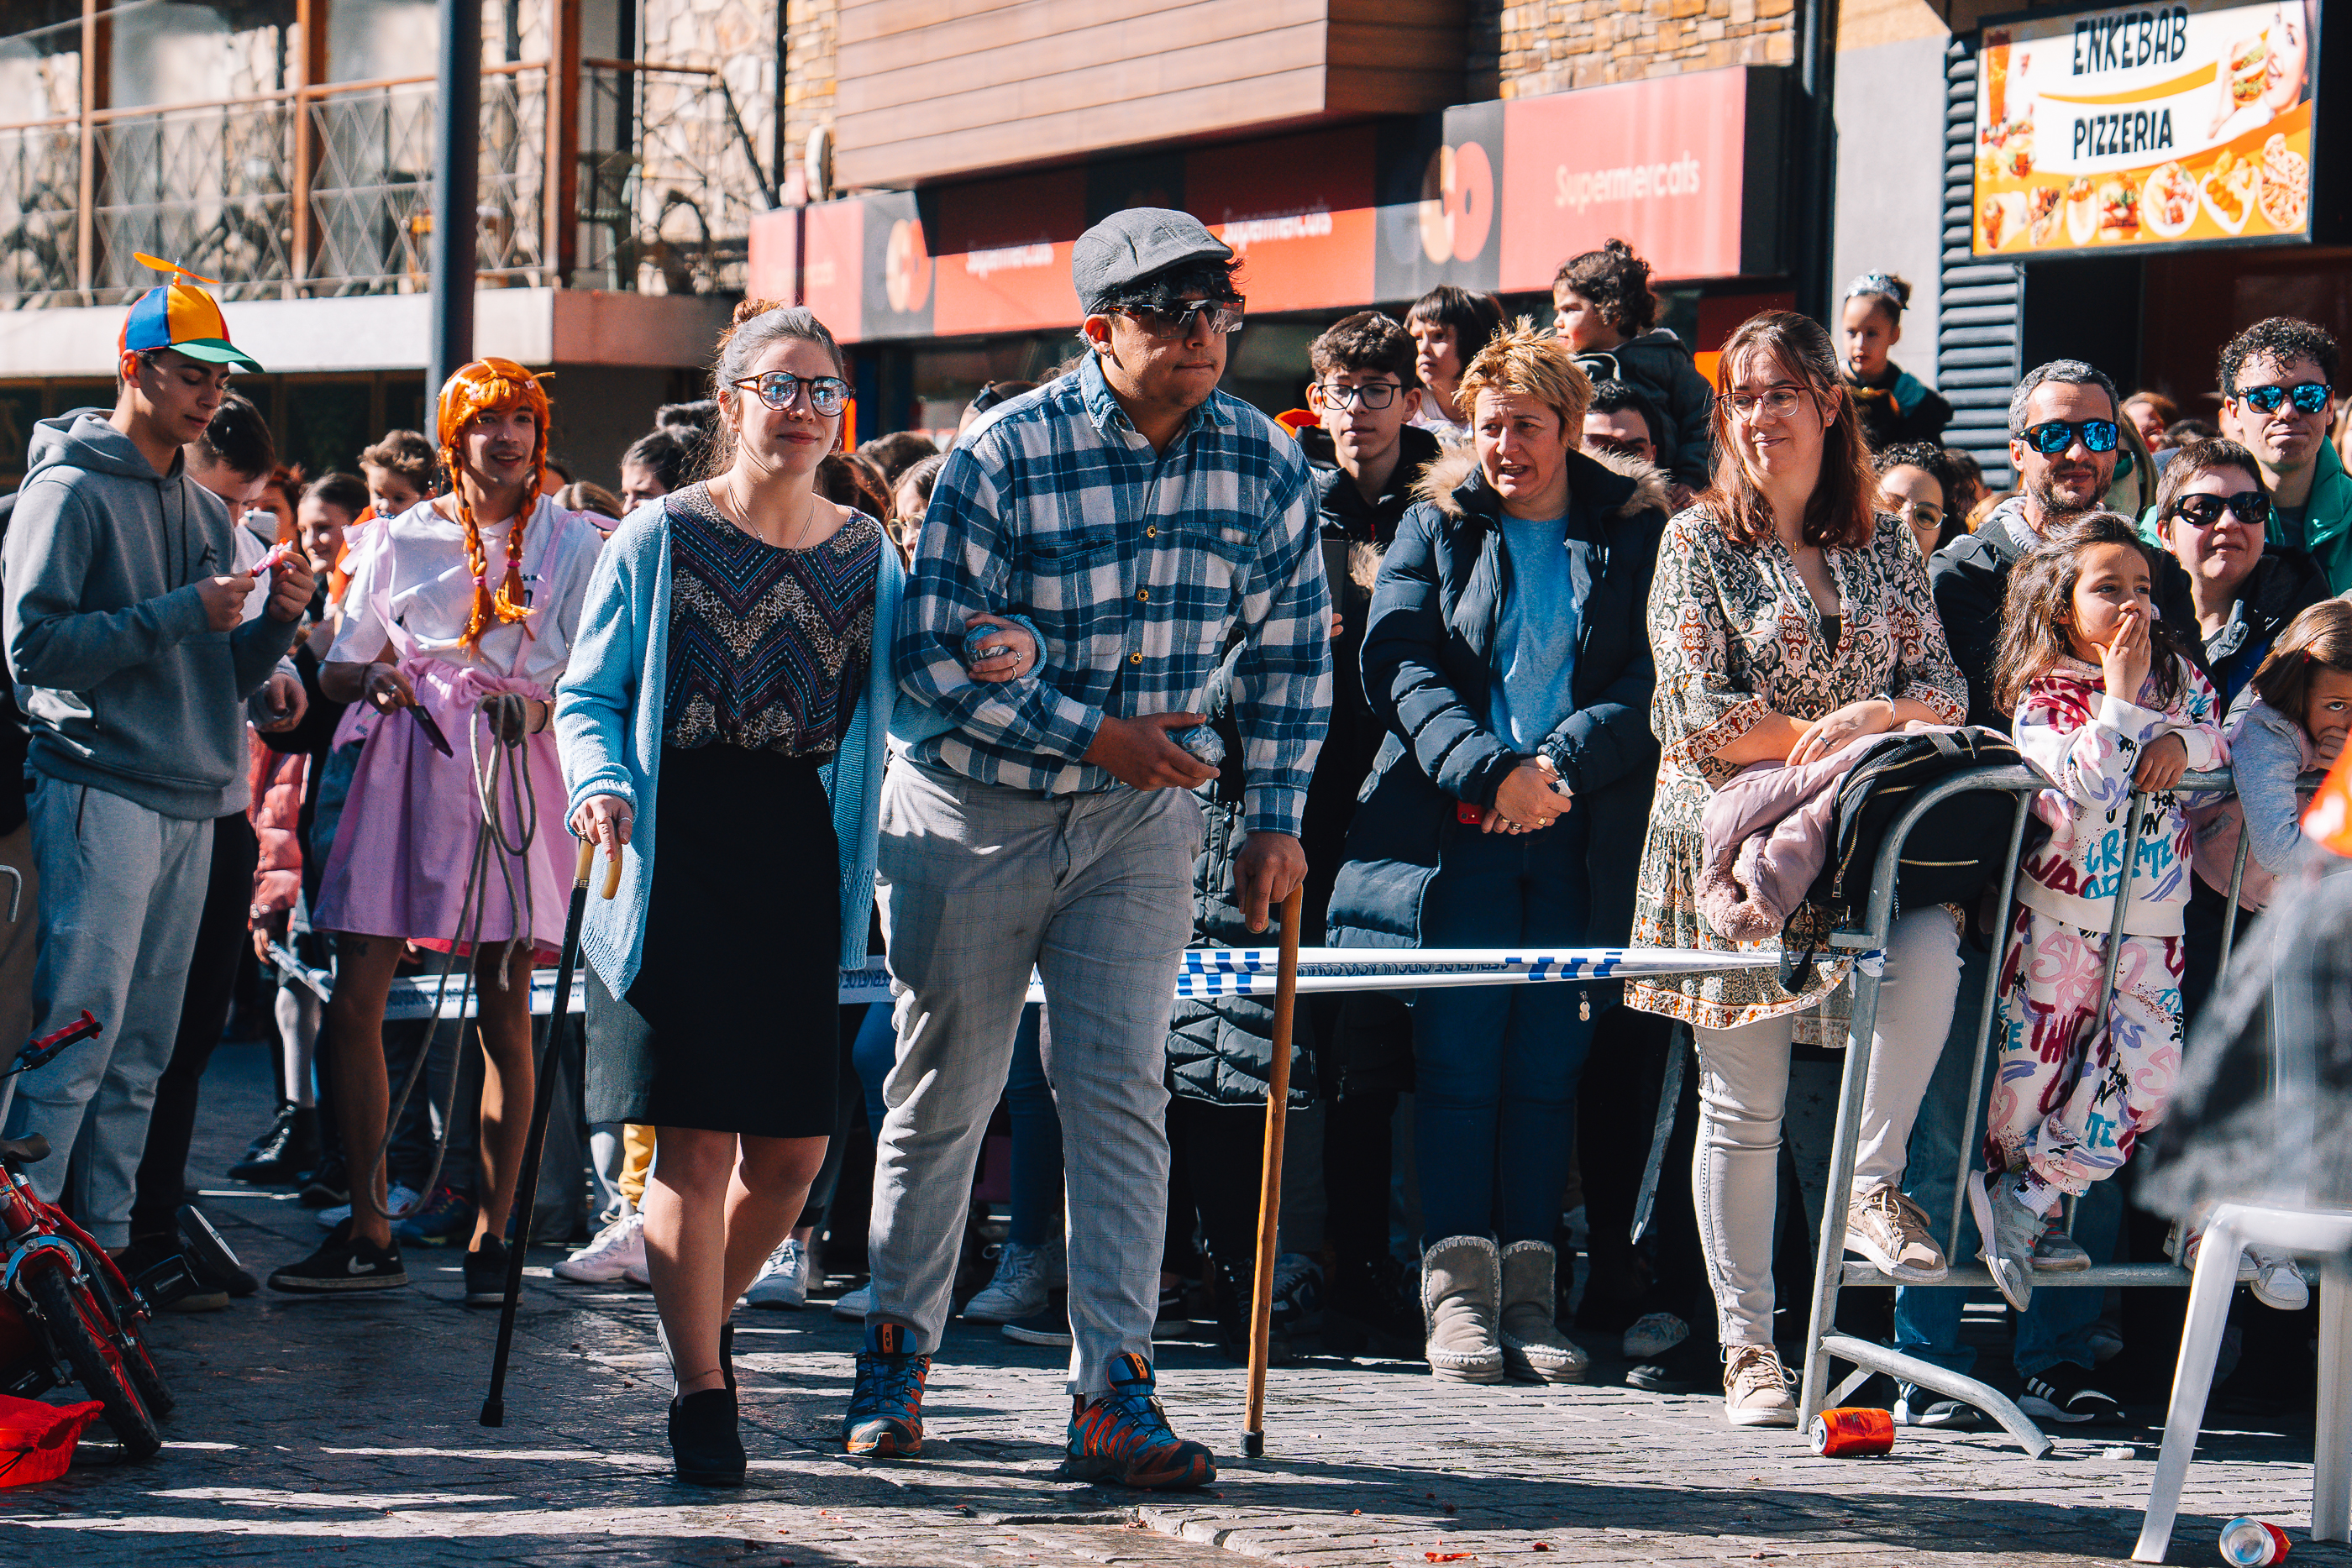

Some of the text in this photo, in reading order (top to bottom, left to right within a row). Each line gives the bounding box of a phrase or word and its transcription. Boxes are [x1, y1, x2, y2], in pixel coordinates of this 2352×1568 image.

[2072, 6, 2188, 76] ENKEBAB
[2073, 107, 2174, 160] PIZZERIA
[1555, 149, 1701, 215] Supermercats
[2085, 829, 2174, 879] CRATE
